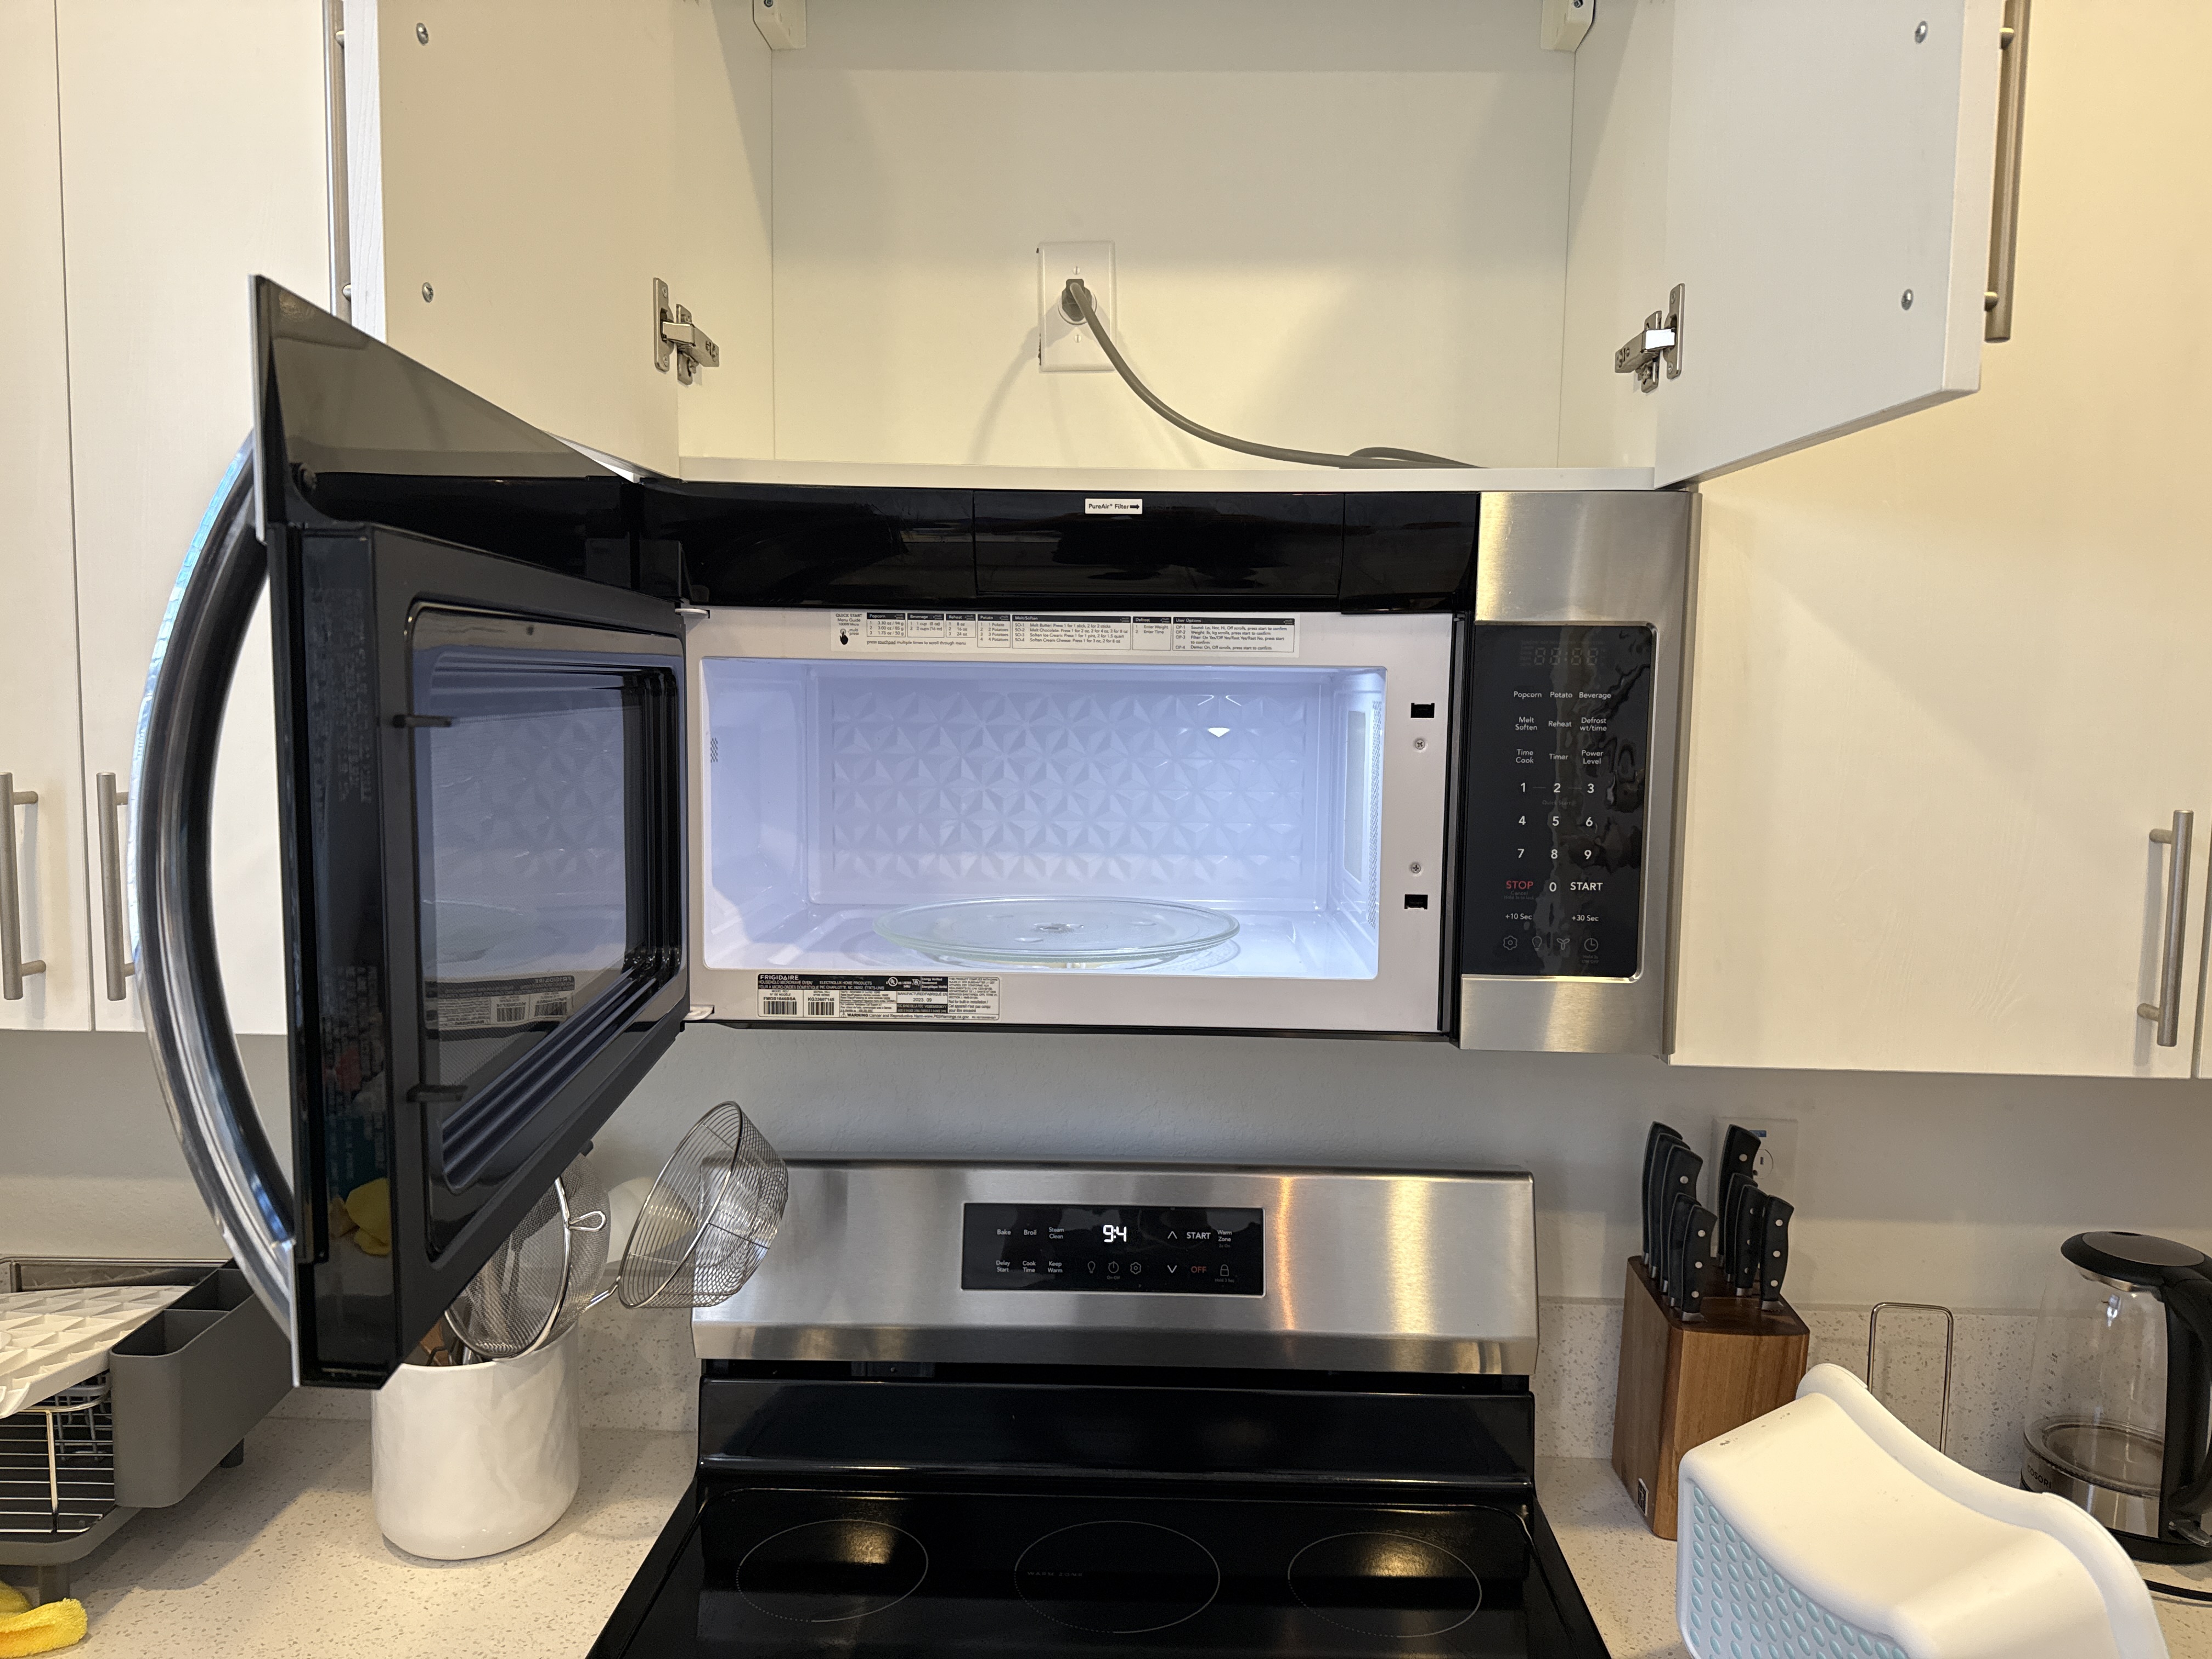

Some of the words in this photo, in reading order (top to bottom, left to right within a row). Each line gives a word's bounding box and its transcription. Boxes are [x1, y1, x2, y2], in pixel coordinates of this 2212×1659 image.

[1514, 691, 1542, 699] Popcorn
[1520, 782, 1526, 792] 1
[1553, 783, 1561, 793] 2
[1587, 783, 1594, 793] 3
[1519, 815, 1526, 825] 4
[1552, 816, 1559, 826] 5
[1585, 817, 1593, 827] 6
[1517, 848, 1525, 858] 7
[1551, 849, 1558, 859] 8
[1584, 850, 1592, 860] 9
[1506, 881, 1533, 889] STOP
[1549, 882, 1556, 892] 0
[1570, 882, 1603, 891] START
[2027, 1464, 2051, 1489] COSORI
